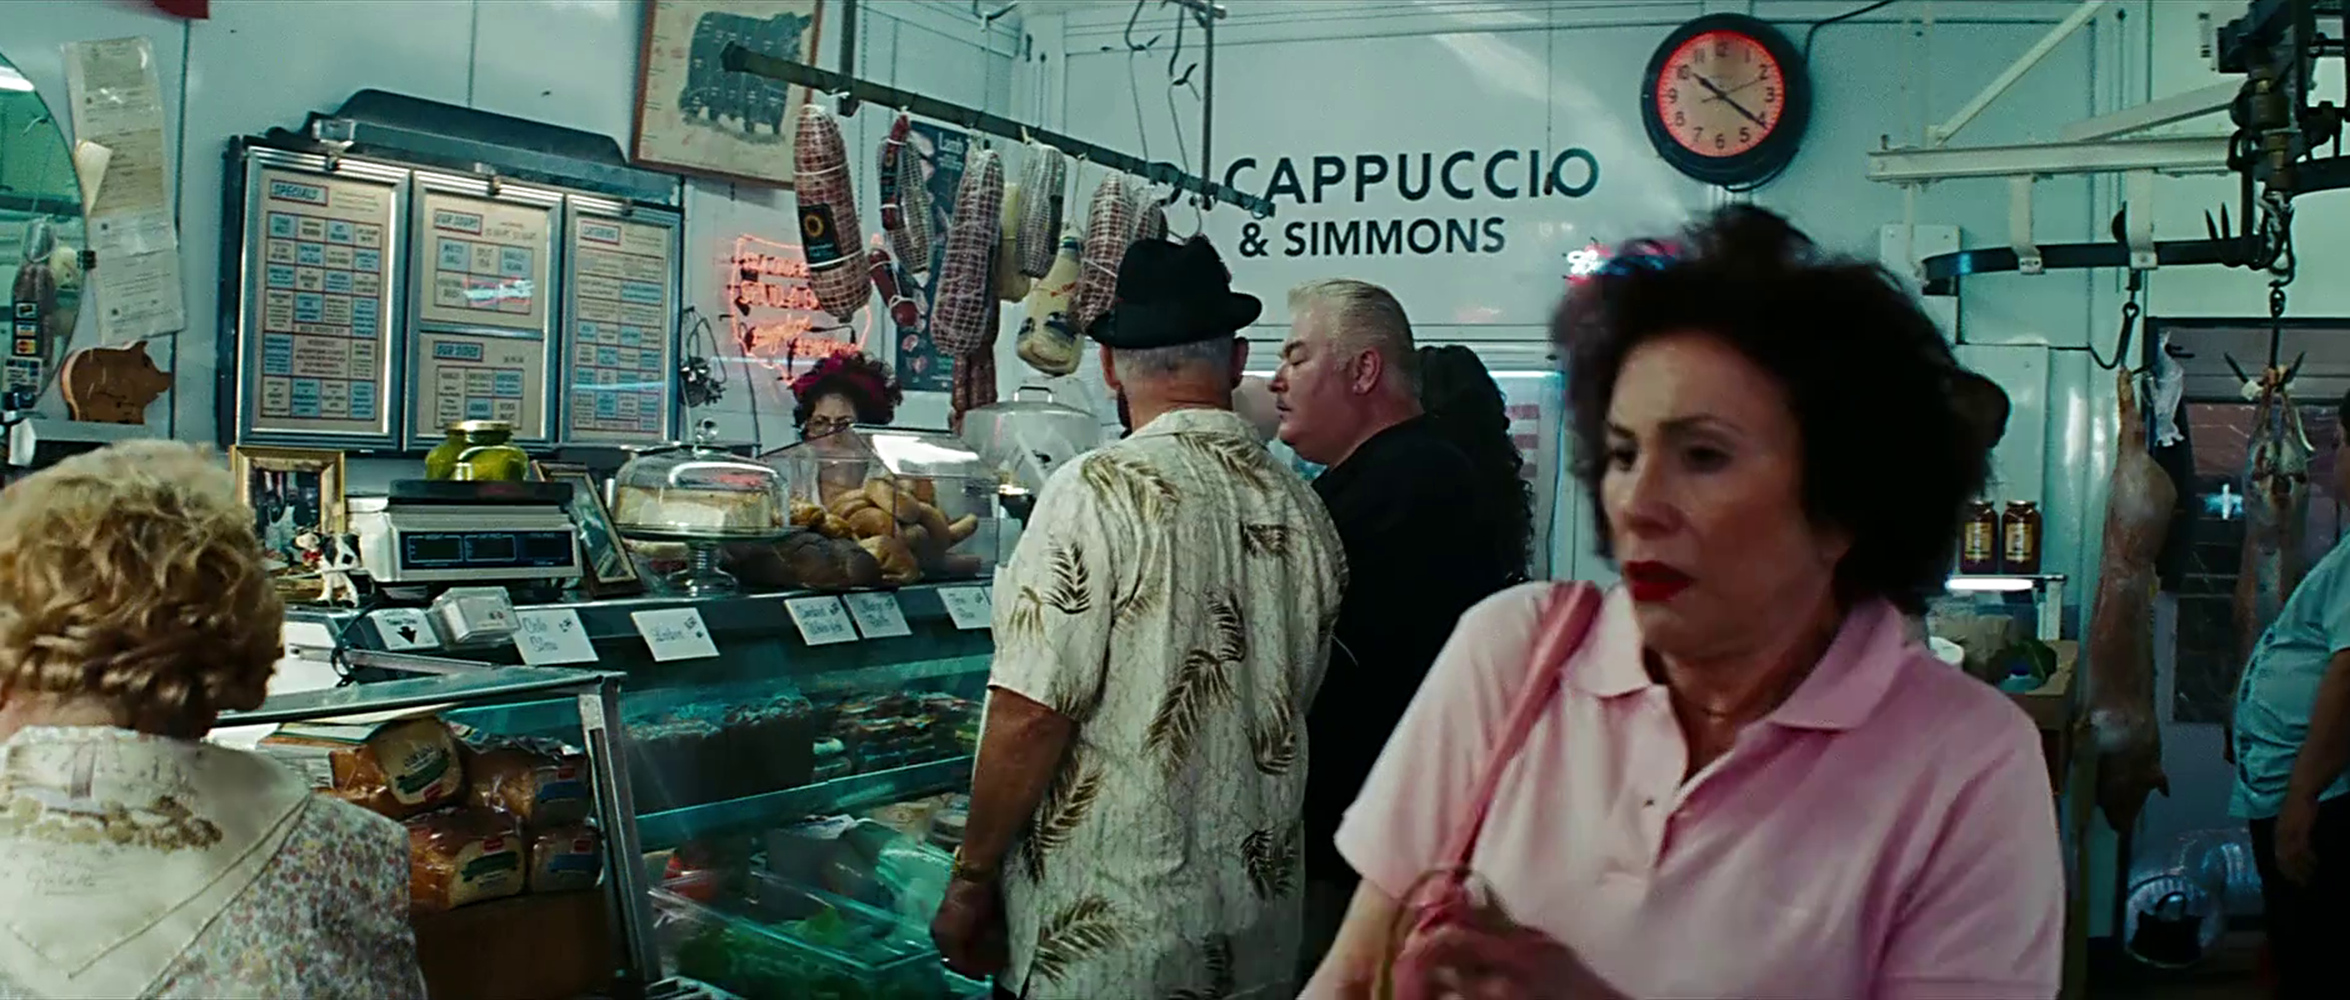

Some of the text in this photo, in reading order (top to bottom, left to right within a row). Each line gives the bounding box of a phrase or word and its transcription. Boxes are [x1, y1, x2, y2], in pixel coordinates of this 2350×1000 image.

[1759, 64, 1769, 80] 2
[1668, 87, 1678, 104] 9
[1765, 87, 1775, 103] 3
[1674, 111, 1686, 127] 8
[1692, 127, 1704, 143] 7
[1715, 133, 1725, 150] 6
[1739, 127, 1751, 143] 5
[1224, 147, 1600, 204] CAPPUCCIO
[273, 183, 320, 200] SPECIALS
[1239, 217, 1506, 257] & SIMMONS
